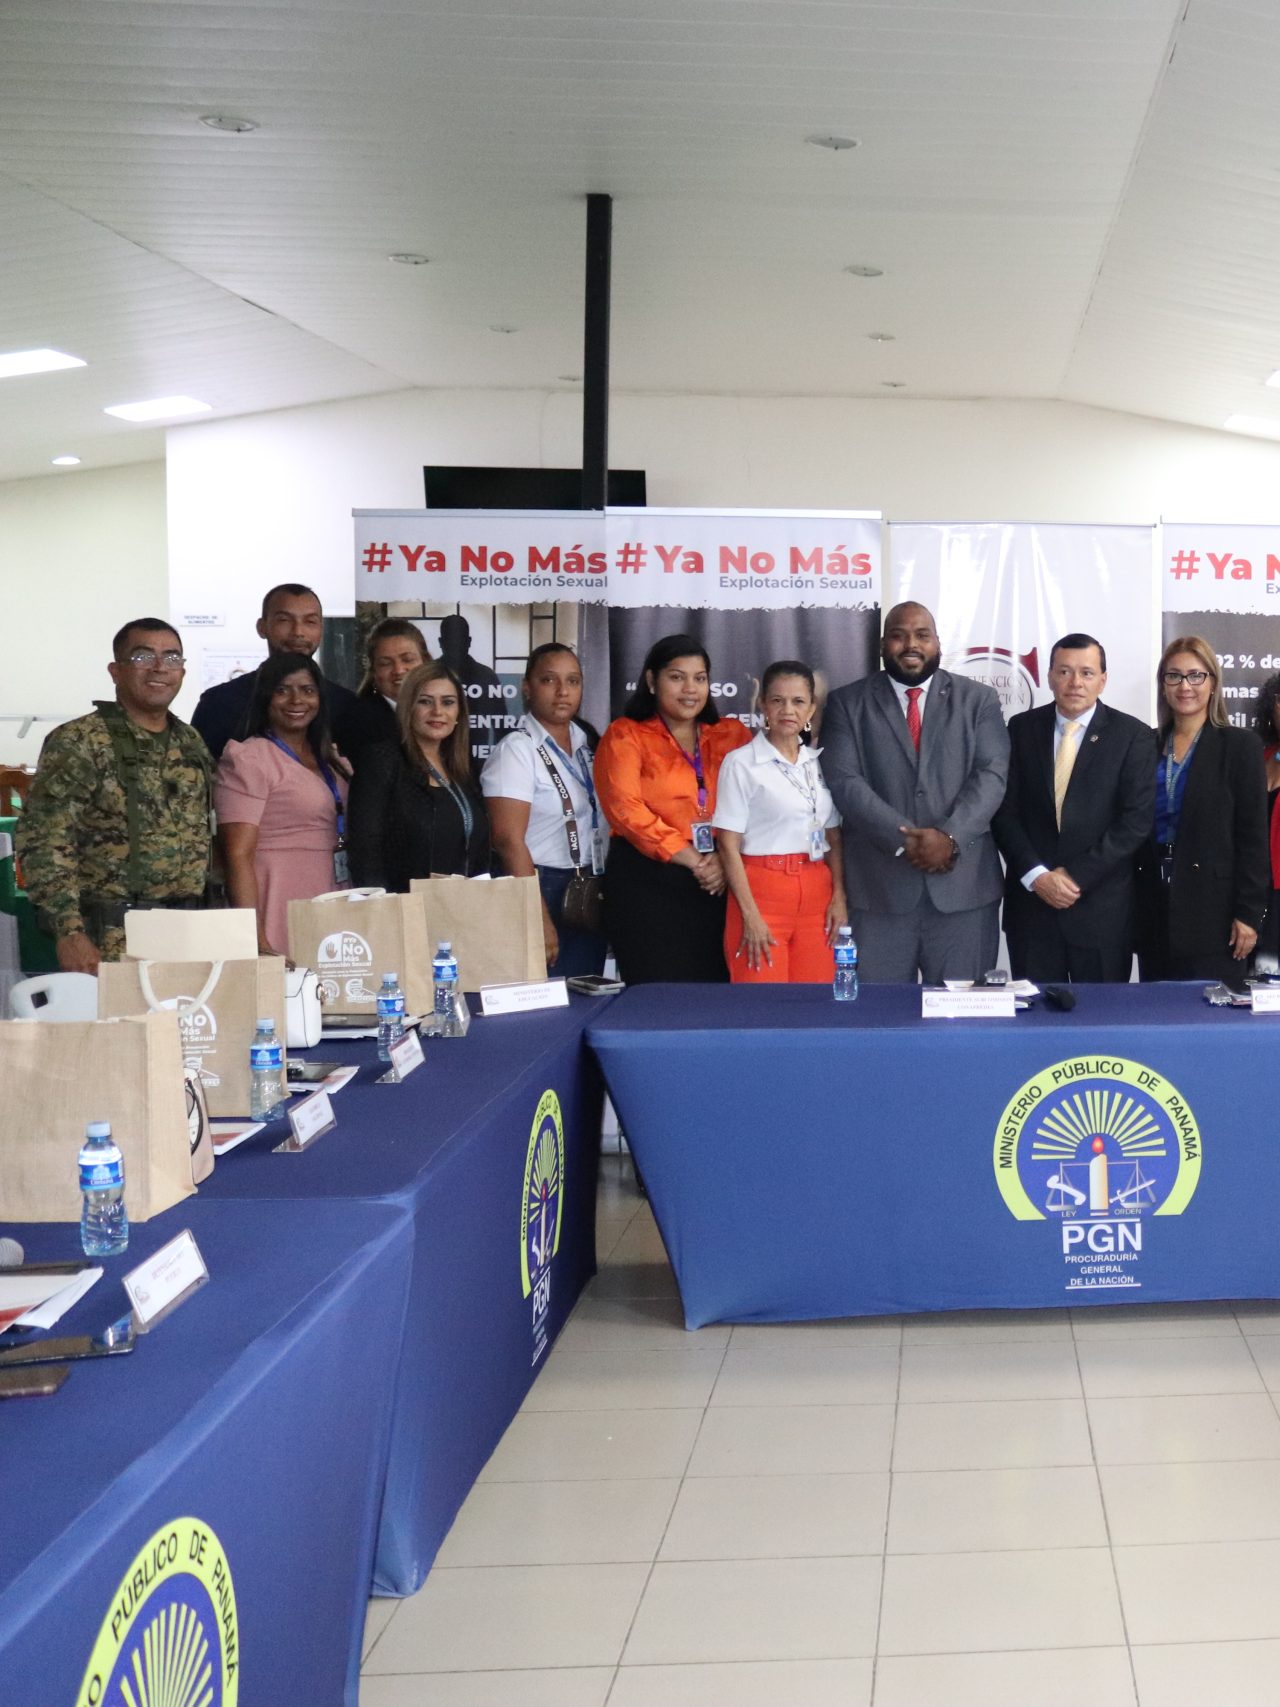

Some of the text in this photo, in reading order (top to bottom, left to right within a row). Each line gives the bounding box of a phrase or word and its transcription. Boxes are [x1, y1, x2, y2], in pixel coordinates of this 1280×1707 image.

[361, 542, 608, 574] #Ya No Más
[615, 542, 873, 576] #Ya No Más
[1169, 550, 1253, 580] #Ya
[460, 574, 608, 589] Explotación Sexual
[719, 576, 873, 591] Explotación Sexual
[1239, 654, 1256, 669] %
[488, 684, 518, 699] NO
[552, 773, 569, 799] COACH
[999, 1060, 1201, 1169] MINISTERIO PÚBLICO DE PANAMÁ
[1061, 1207, 1142, 1218] LEY ORDEN
[1062, 1222, 1142, 1254] PGN
[1064, 1252, 1139, 1264] PROCURADURÍA
[1080, 1265, 1124, 1275] GENERAL
[1070, 1275, 1135, 1286] DE LA NACIÓN
[532, 1270, 551, 1326] PGN
[111, 1532, 179, 1643] PÚBLICO
[188, 1529, 208, 1567] DE
[211, 1557, 238, 1688] PANAMÁ
